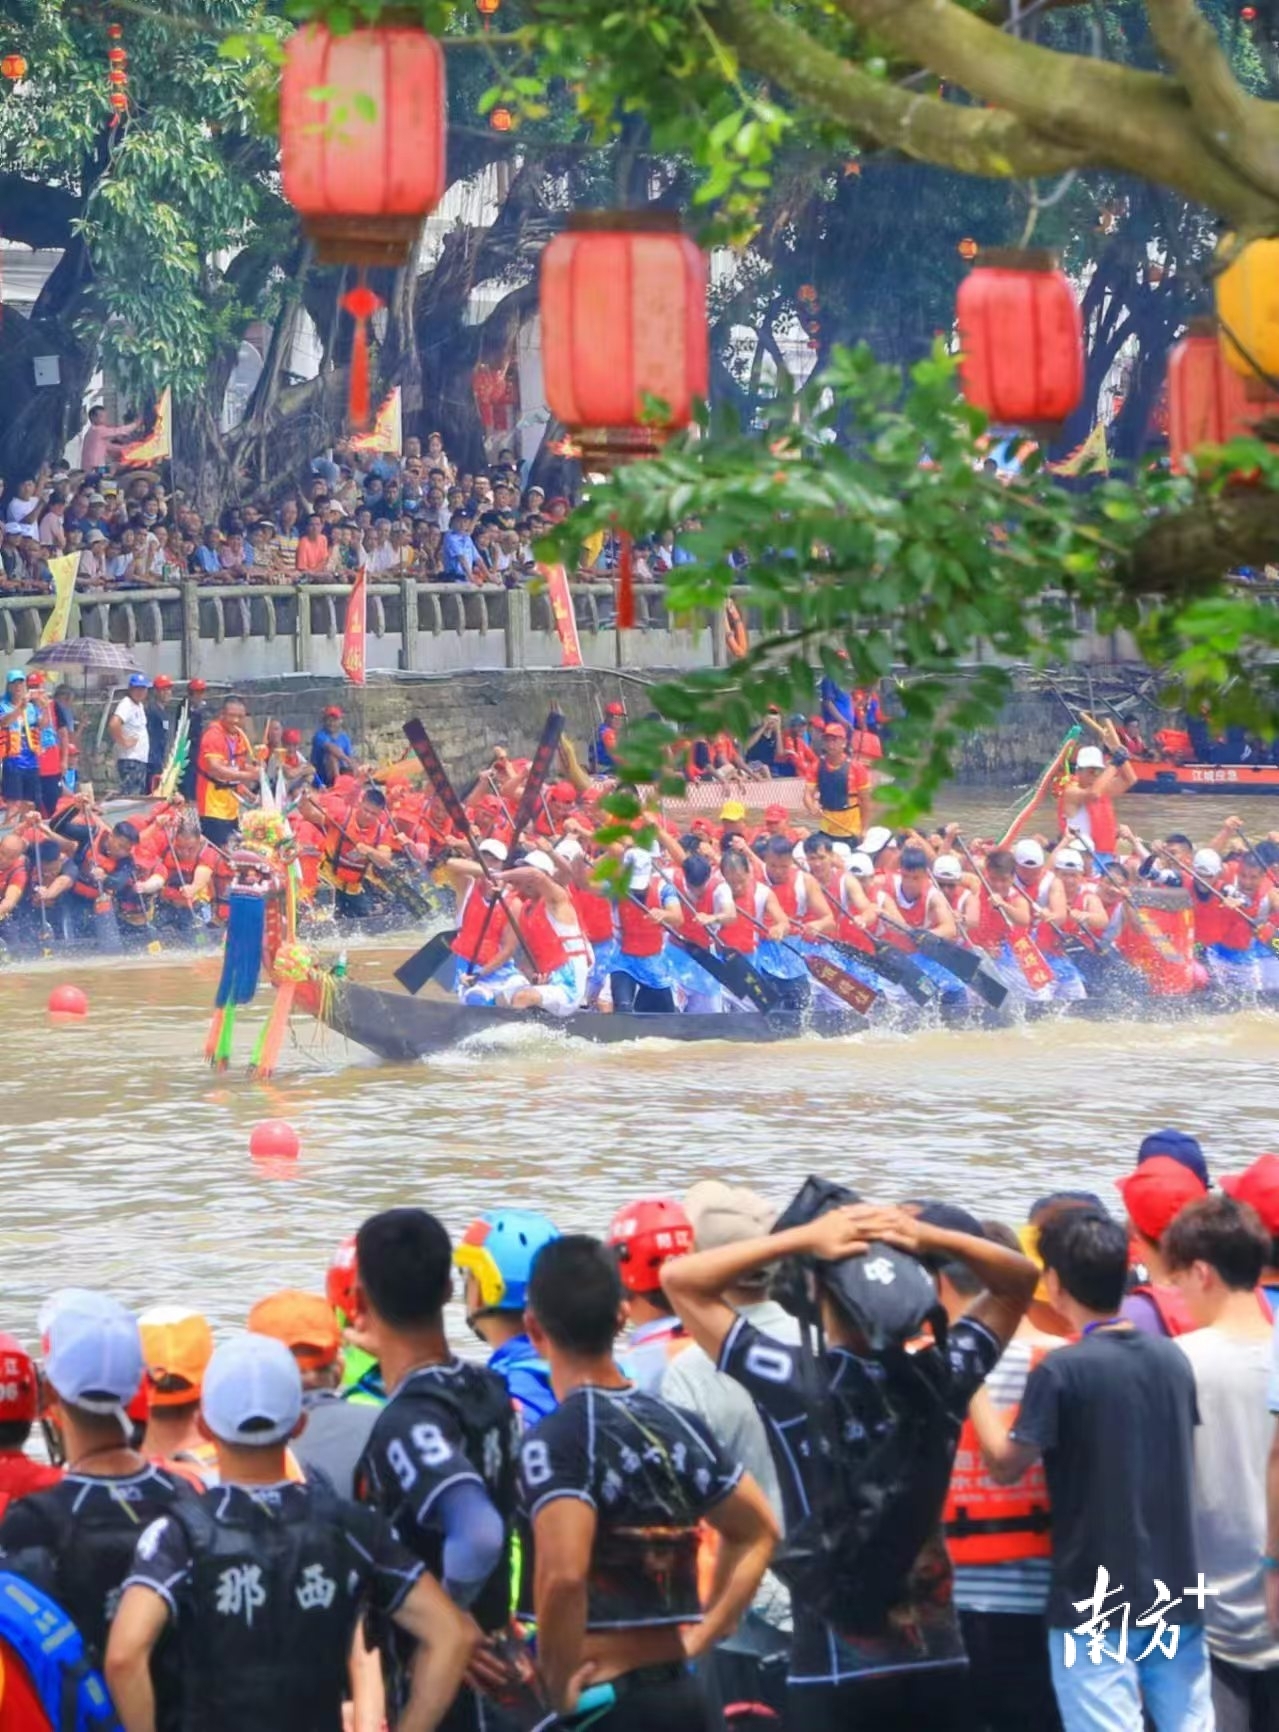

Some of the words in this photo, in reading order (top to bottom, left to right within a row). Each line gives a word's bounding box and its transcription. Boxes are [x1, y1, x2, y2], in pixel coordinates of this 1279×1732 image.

[387, 1423, 453, 1491] 99
[527, 1440, 553, 1486] 8
[215, 1563, 337, 1628] 那西
